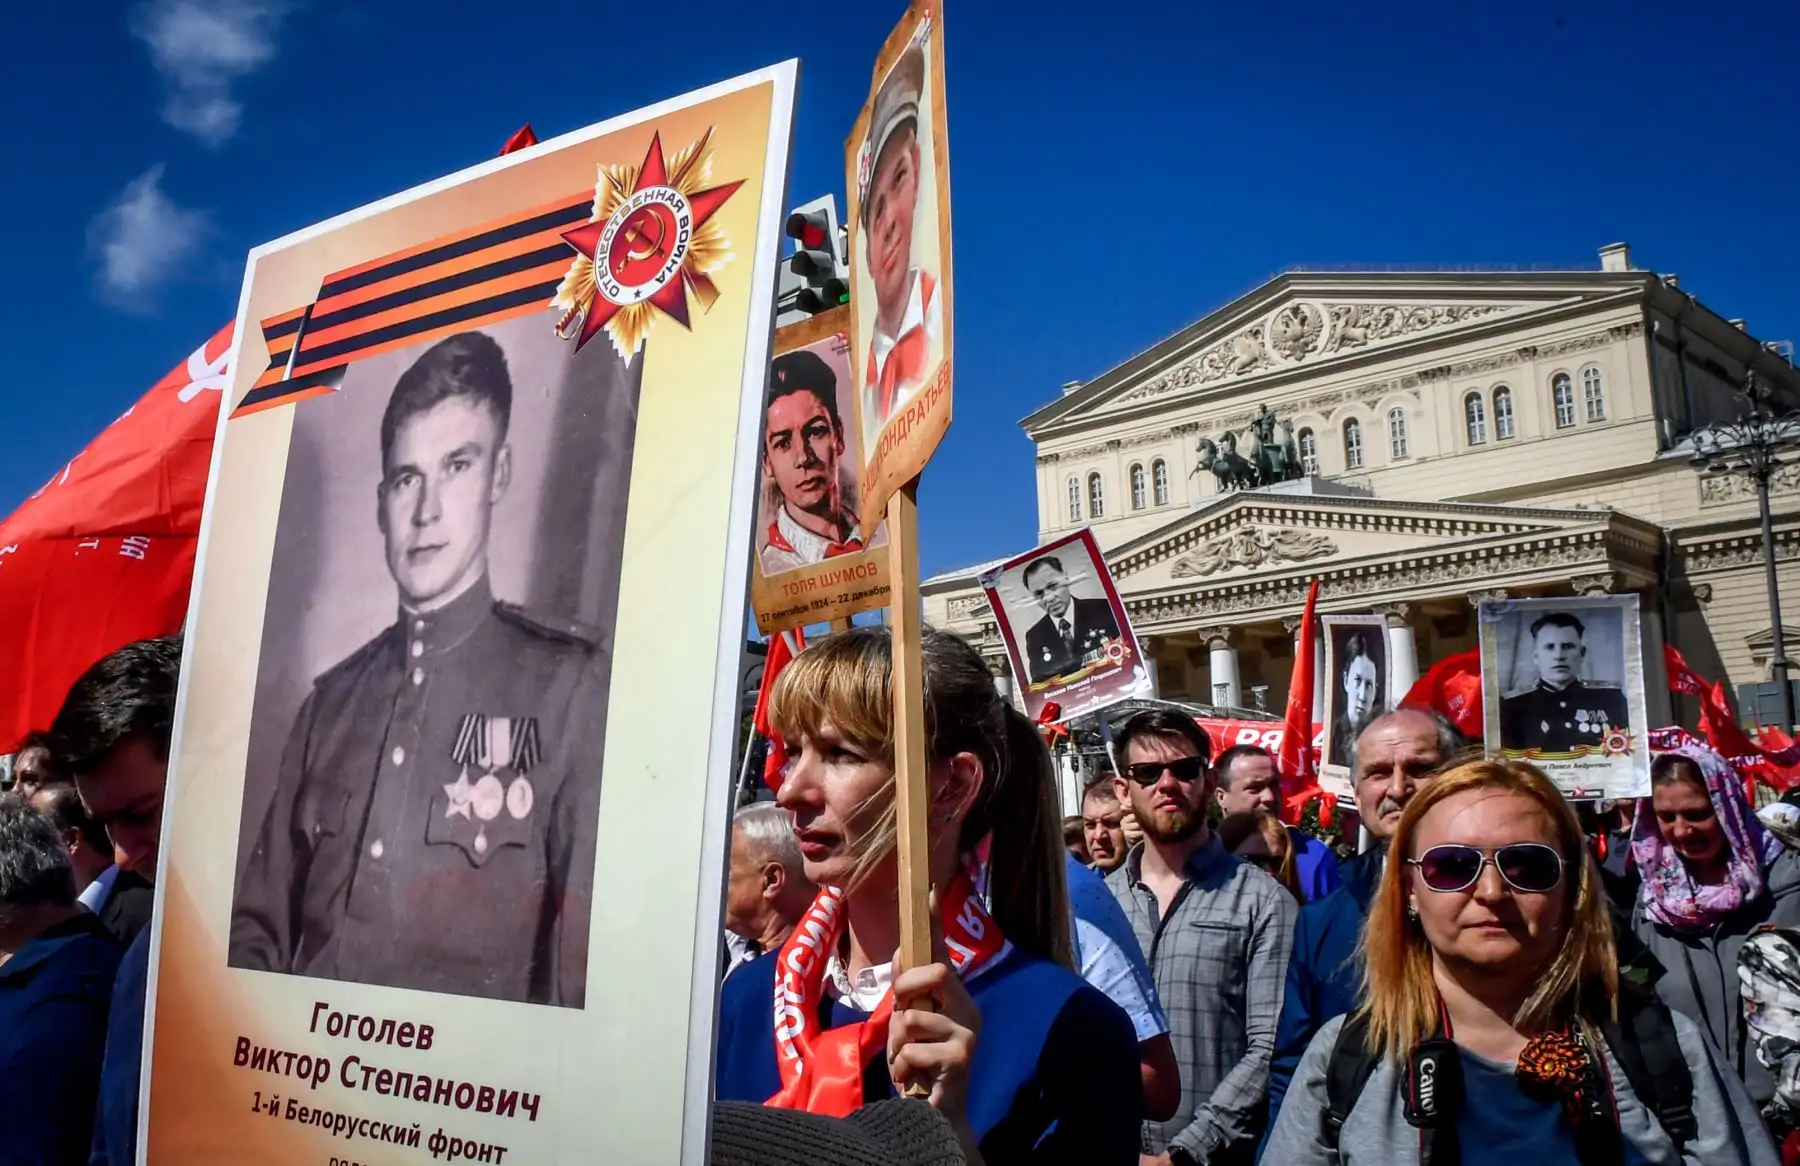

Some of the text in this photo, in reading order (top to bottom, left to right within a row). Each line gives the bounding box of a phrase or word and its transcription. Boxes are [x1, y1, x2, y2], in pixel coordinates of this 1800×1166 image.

[598, 189, 685, 298] ОТЕЧЕСТВЕННАЯ
[760, 612, 770, 622] 27
[837, 593, 849, 604] 22
[851, 584, 891, 602] декабря
[782, 562, 878, 597] ТОЛЯ ШУМОВ
[308, 1002, 434, 1051] Гоголев
[232, 1035, 541, 1122] Виктор Степанович
[251, 1091, 508, 1165] 1-й Белорусский фронт
